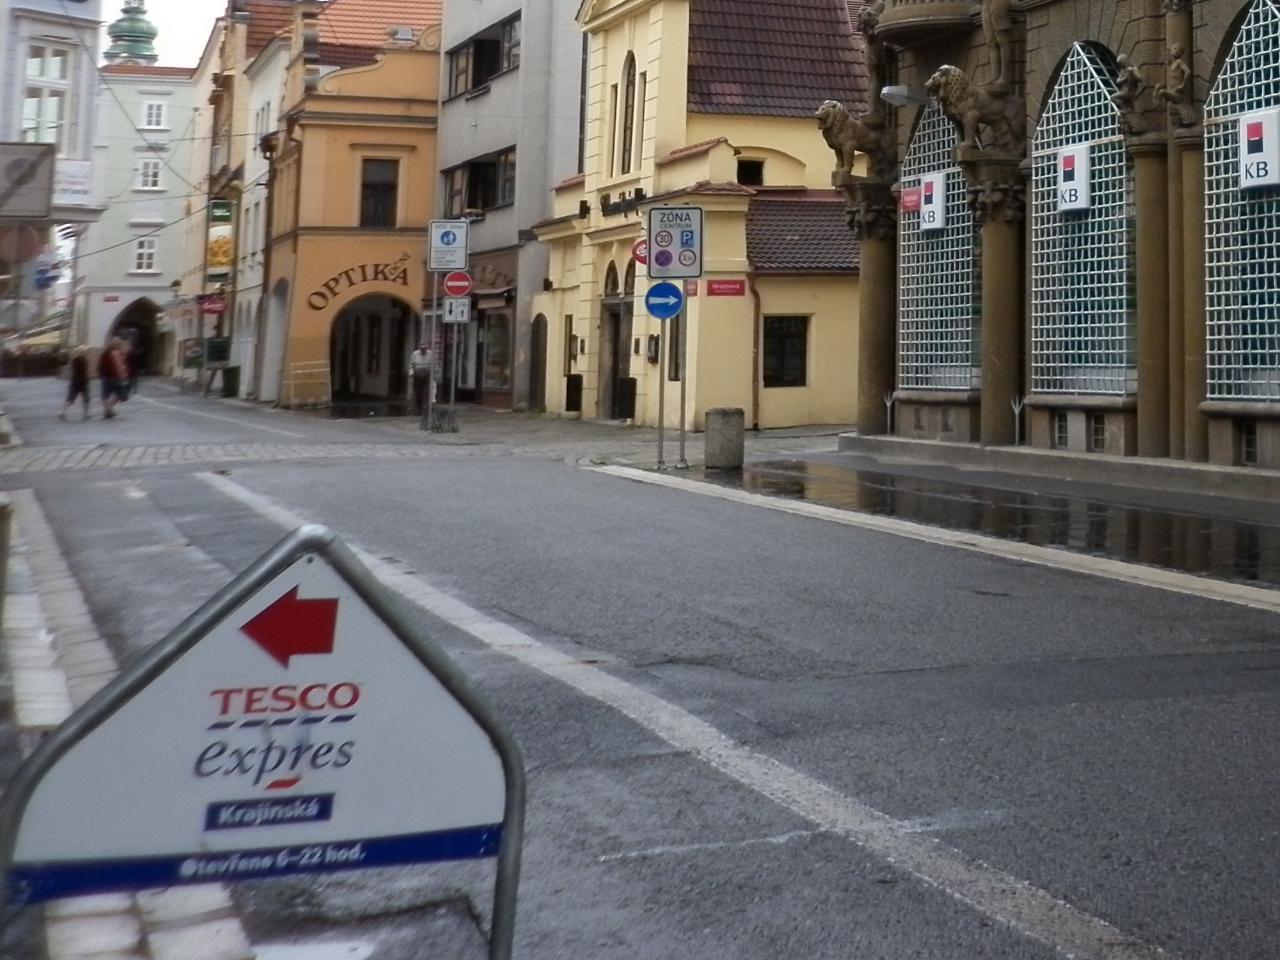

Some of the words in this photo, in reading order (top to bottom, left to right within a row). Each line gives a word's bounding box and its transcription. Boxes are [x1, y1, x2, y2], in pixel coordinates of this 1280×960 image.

[1243, 161, 1269, 179] KB
[1060, 188, 1079, 204] KB
[660, 210, 692, 223] ZÓNA
[922, 210, 936, 224] KB
[658, 233, 669, 243] 30
[307, 262, 409, 311] OPTIKA
[211, 682, 360, 715] TESCO
[194, 740, 355, 786] expres
[217, 798, 321, 826] Krajinská
[325, 842, 367, 863] hod.
